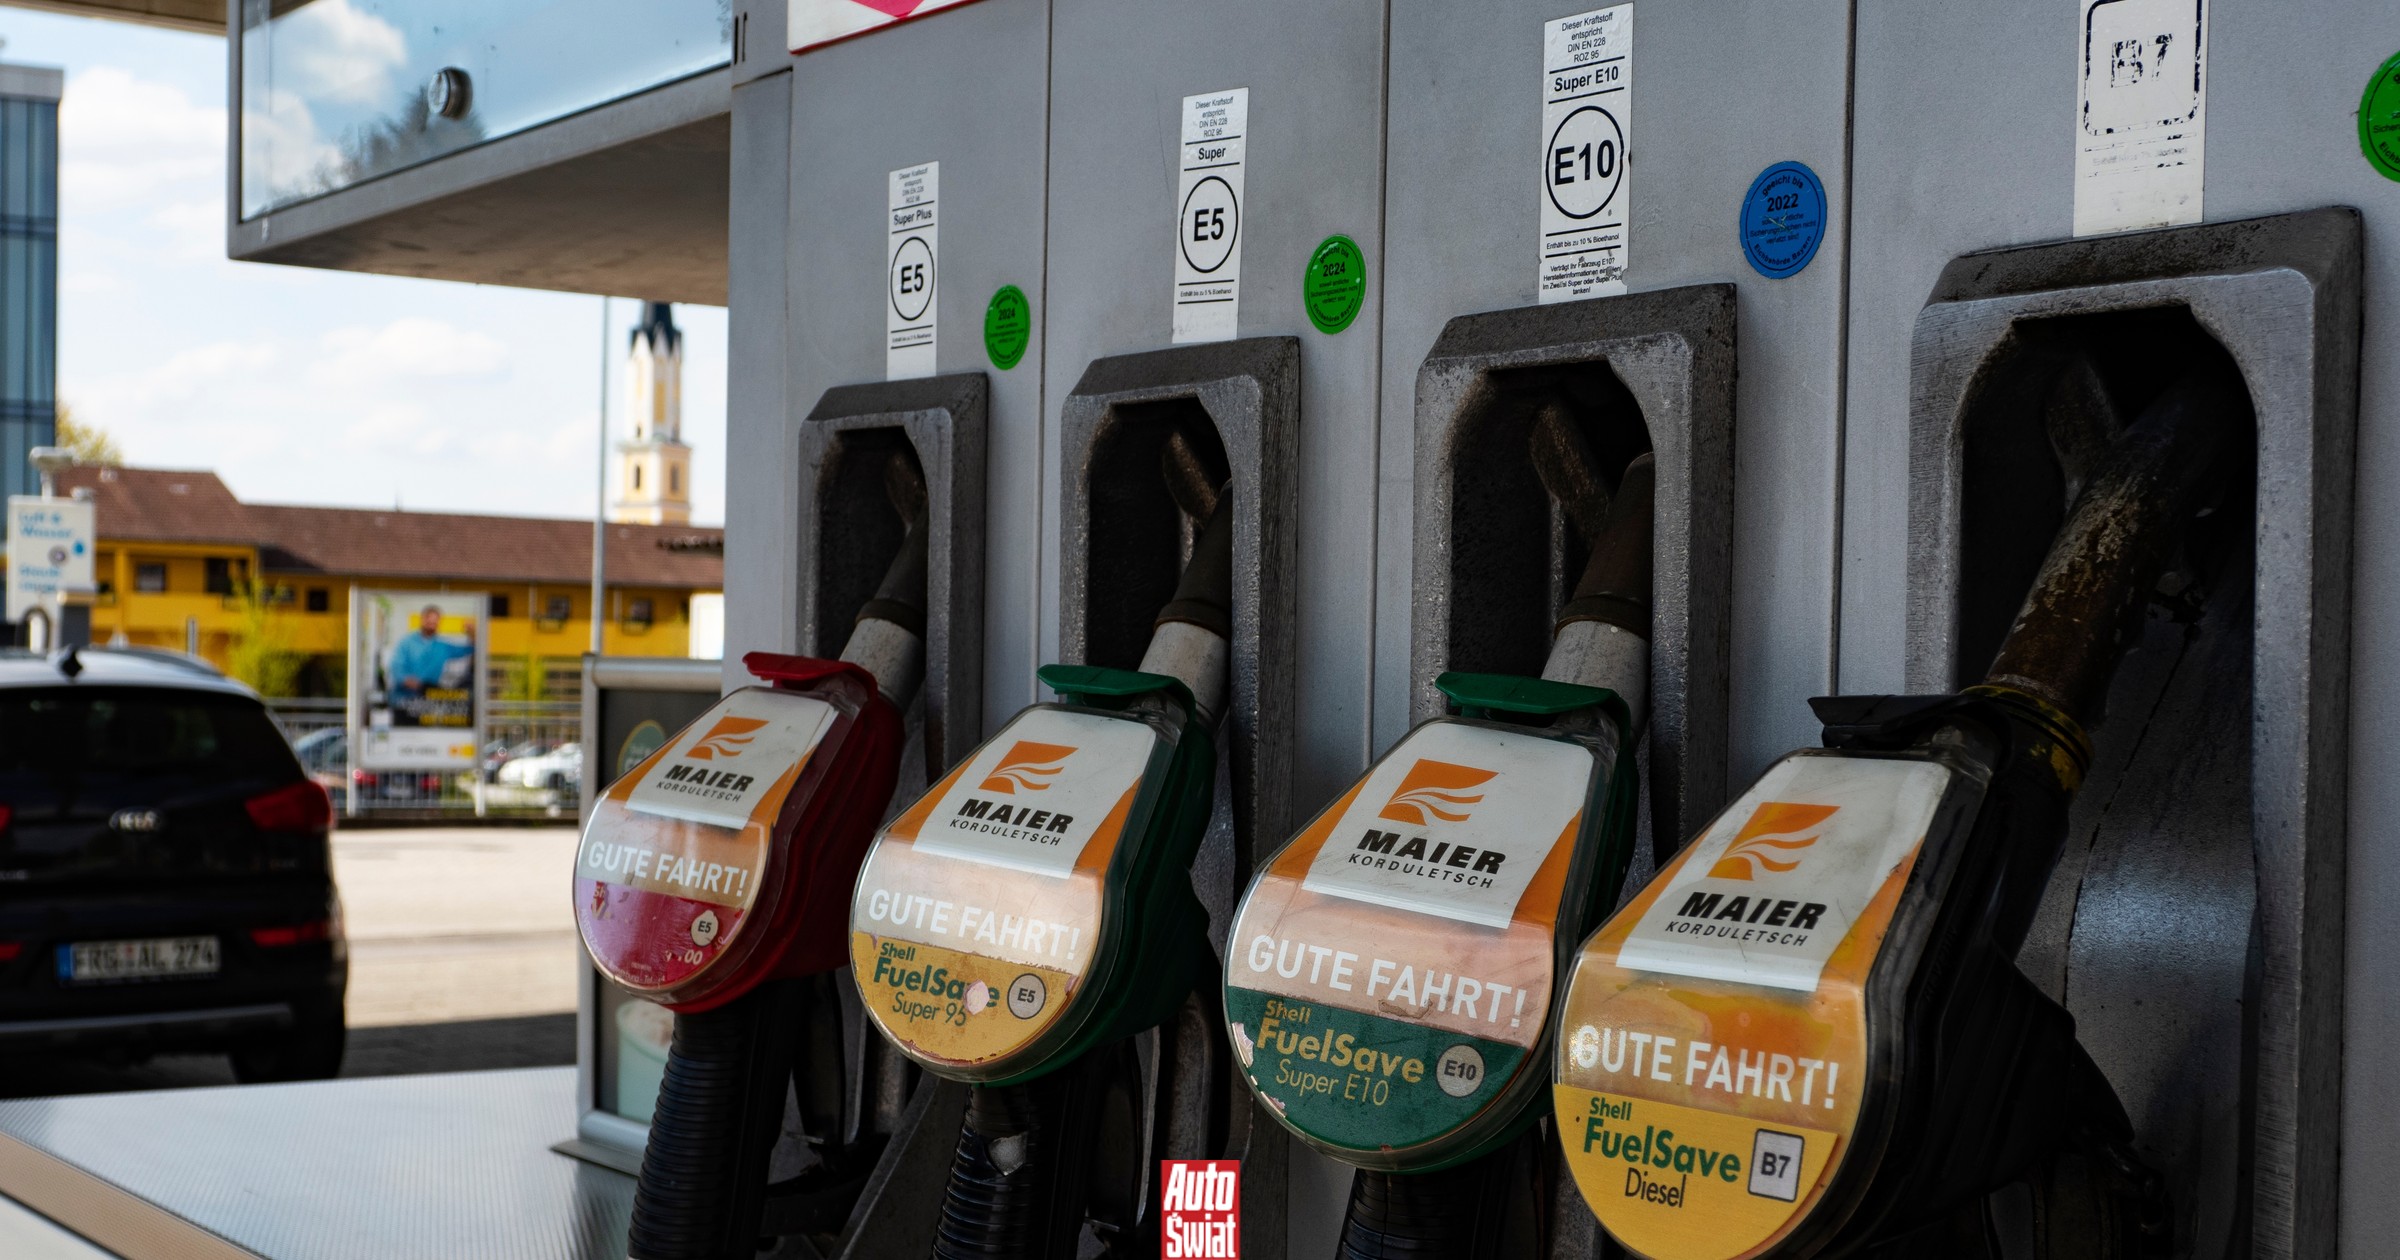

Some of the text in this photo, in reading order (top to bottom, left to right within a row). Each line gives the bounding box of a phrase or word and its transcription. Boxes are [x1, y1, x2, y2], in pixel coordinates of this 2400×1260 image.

[1561, 12, 1614, 32] Dieser Kraftstoff
[1571, 27, 1603, 41] entspricht
[1567, 37, 1606, 53] DIN EN 228
[1573, 50, 1599, 63] ROZ 95
[2111, 33, 2174, 88] B7
[1554, 65, 1619, 93] Super E10
[1198, 147, 1226, 162] Super
[1555, 139, 1615, 186] E10
[1762, 175, 1803, 197] geeicht bis
[1767, 194, 1799, 212] 2022
[893, 208, 932, 227] Super Plus
[1193, 207, 1224, 242] E5
[1546, 240, 1563, 249] Enthält
[1593, 233, 1619, 243] Bioethanol
[901, 263, 924, 295] E5
[1323, 262, 1346, 277] 2024
[1550, 264, 1569, 272] Verträgt
[1578, 260, 1601, 269] Fahrzeug
[1568, 279, 1582, 287] Super
[1573, 287, 1591, 295] tanken!
[656, 781, 741, 803] KORDULETSCH
[664, 764, 754, 792] MAIER
[957, 798, 1074, 834] MAIER
[949, 818, 1062, 847] KORDULETSCH
[1357, 828, 1507, 875] MAIER
[588, 841, 749, 898] GUTE FAHRT!
[1348, 853, 1494, 889] KORDULETSCH
[869, 889, 1081, 960] GUTE FAHRT!
[1677, 891, 1828, 931] MAIER
[698, 920, 712, 933] E5
[1664, 920, 1809, 947] KORDULETSCH
[880, 942, 915, 962] Shell
[873, 957, 1001, 1009] FuelSae
[1017, 987, 1036, 1004] E5
[1247, 935, 1527, 1028] GUTE FAHRT!
[892, 991, 967, 1027] Super 95
[1265, 1000, 1312, 1025] Shell
[1257, 1017, 1425, 1084] FuelSave
[1443, 1059, 1477, 1081] E10
[1574, 1024, 1839, 1110] GUTE FAHRT!
[1276, 1058, 1389, 1107] Super E10
[1589, 1097, 1632, 1122] Shell
[1583, 1118, 1741, 1182] FuelSave
[1760, 1151, 1791, 1179] B7
[1624, 1167, 1687, 1208] Diesel
